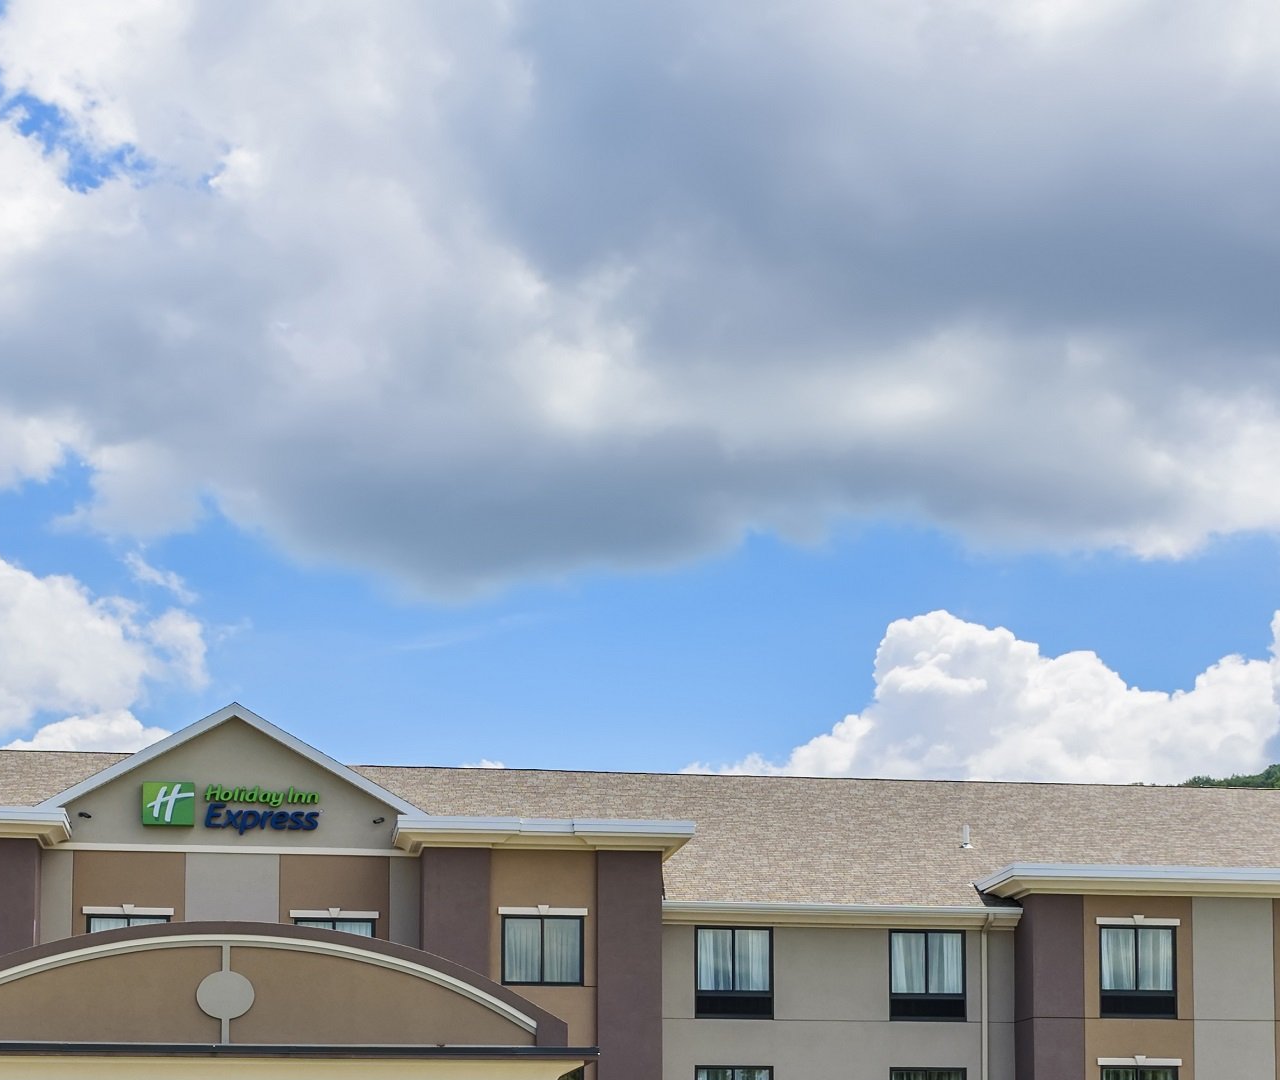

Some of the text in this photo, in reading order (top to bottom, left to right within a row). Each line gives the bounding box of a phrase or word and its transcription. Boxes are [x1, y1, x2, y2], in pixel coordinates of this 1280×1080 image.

[204, 784, 320, 807] Holiday Inn
[204, 803, 320, 835] Express
